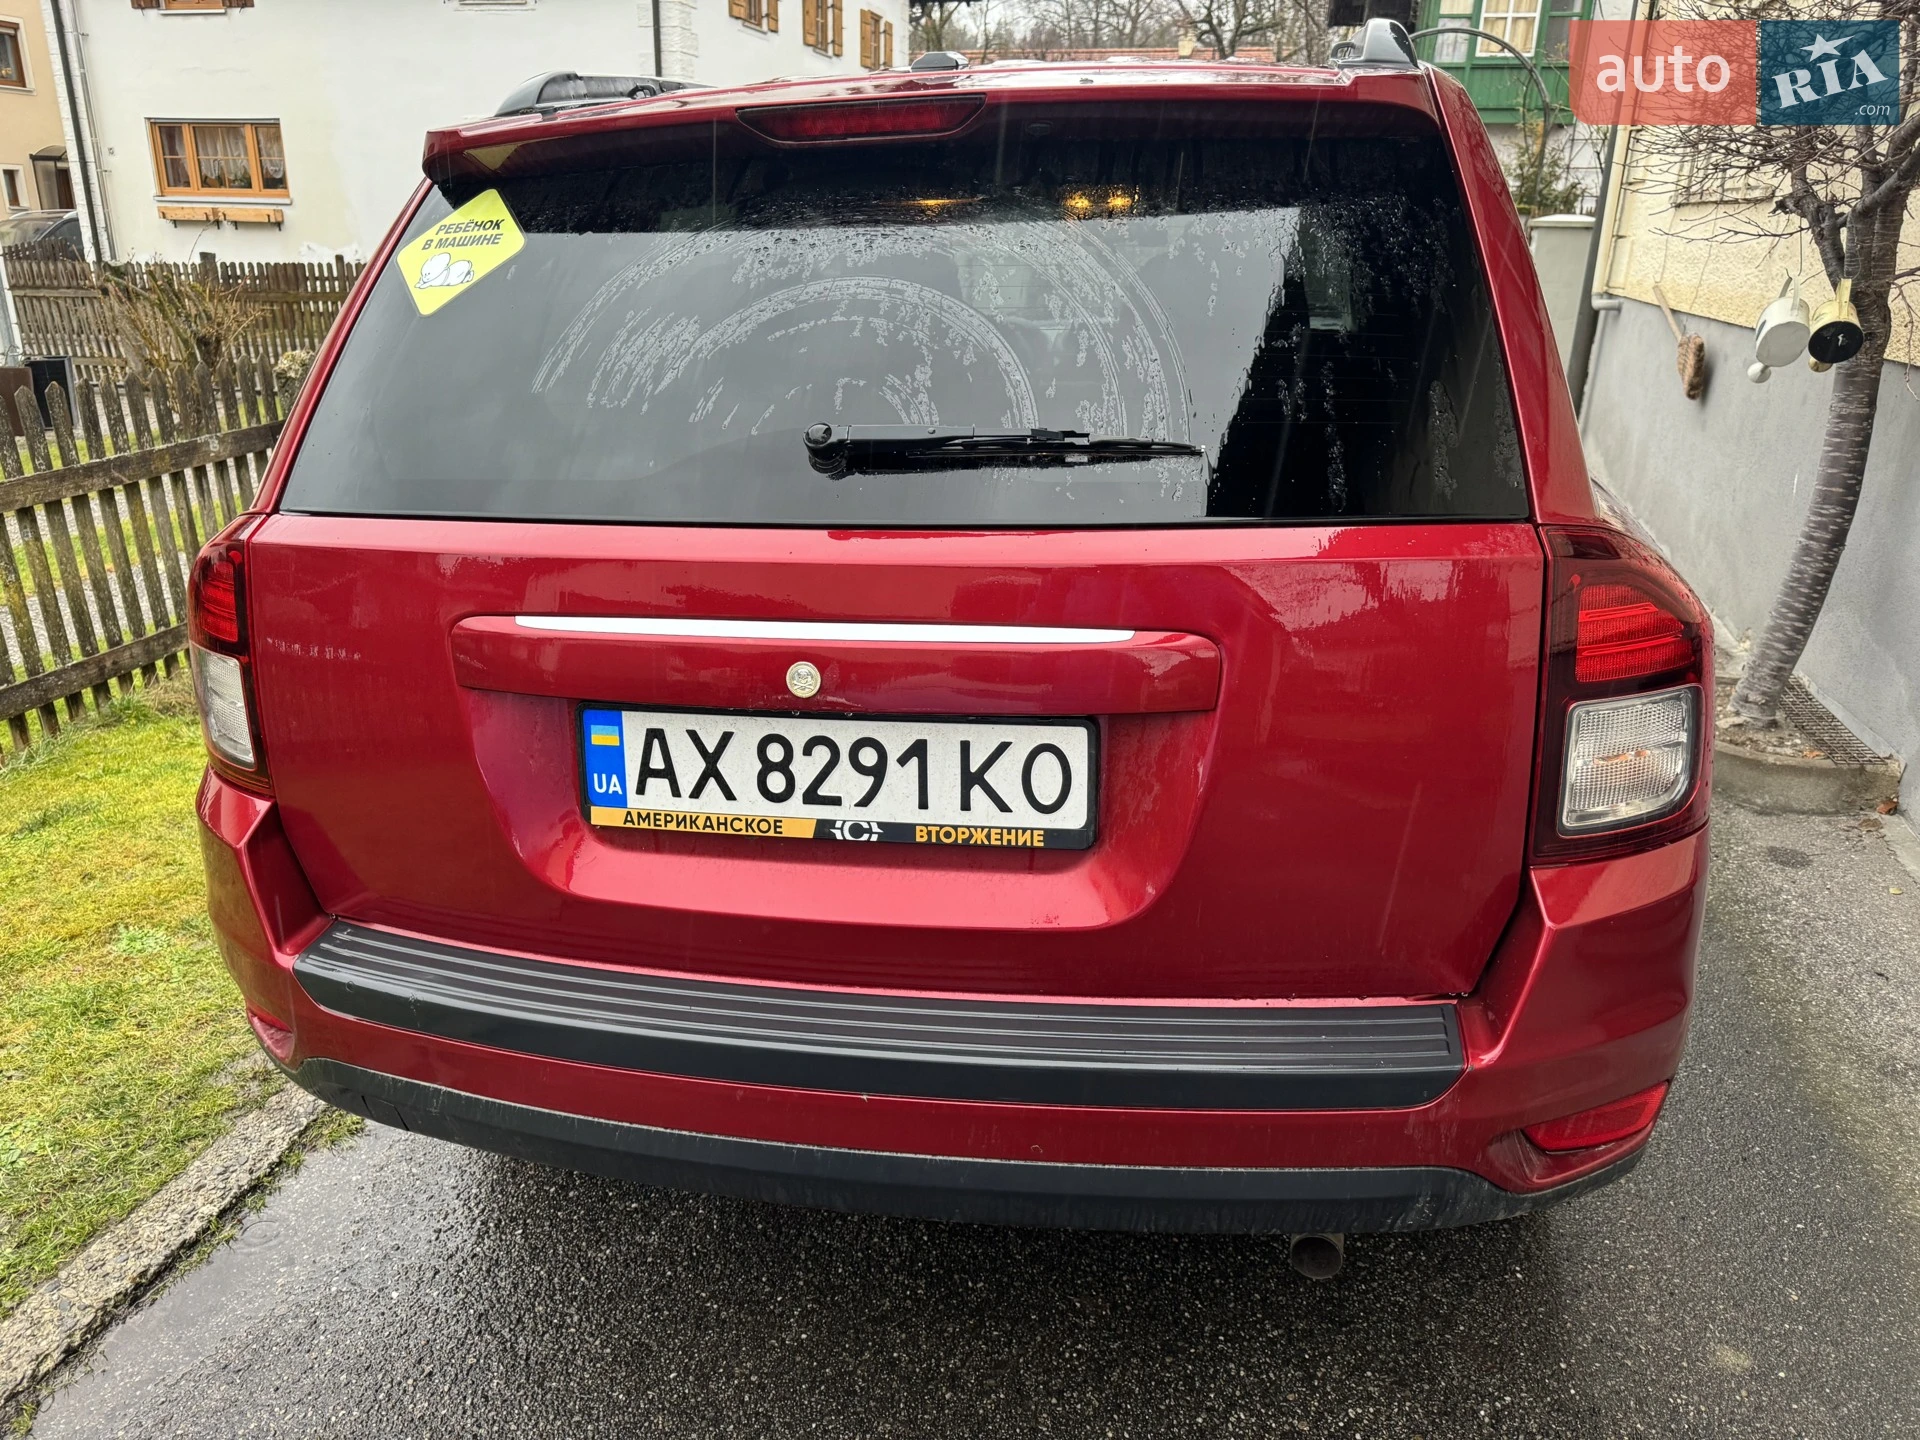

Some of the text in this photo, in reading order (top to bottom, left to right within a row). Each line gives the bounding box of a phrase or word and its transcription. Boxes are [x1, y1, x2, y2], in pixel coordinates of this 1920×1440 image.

[435, 219, 505, 235] РЕБЁНОК
[421, 233, 504, 251] В МАШИНЕ
[635, 728, 1072, 815] AX 8291 KO
[593, 772, 622, 796] UA
[623, 810, 1045, 847] АМЕРИКАНСКОЕ ВТОРЖЕНИЕ
